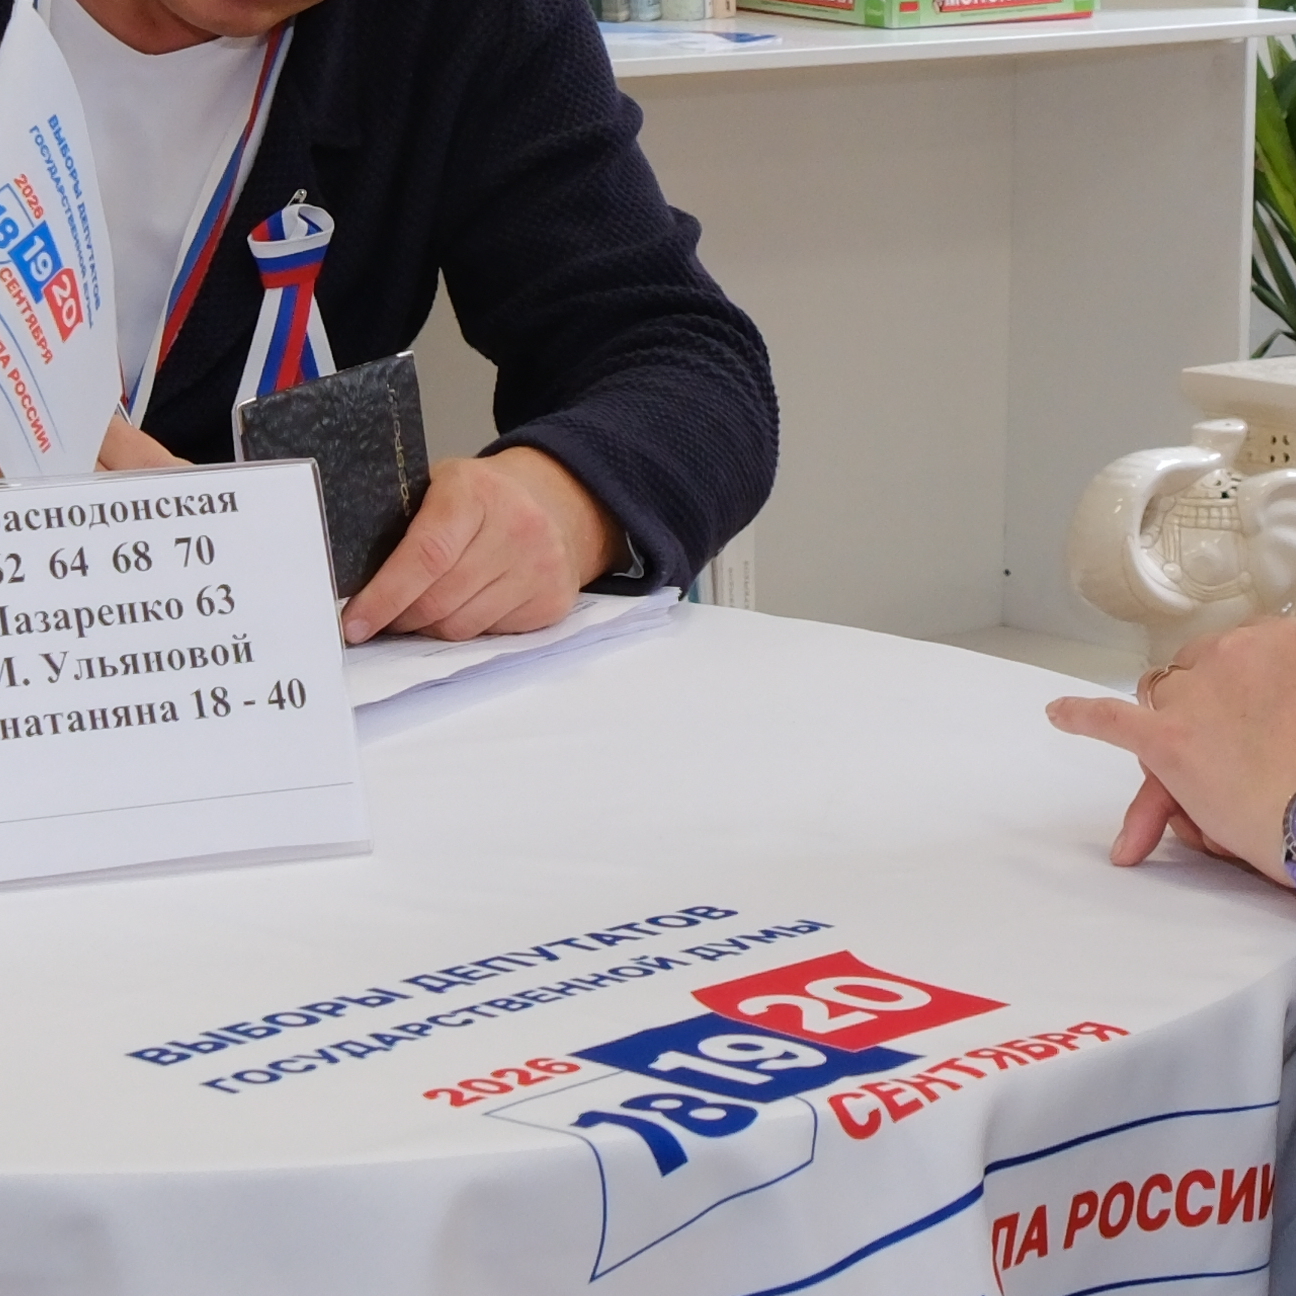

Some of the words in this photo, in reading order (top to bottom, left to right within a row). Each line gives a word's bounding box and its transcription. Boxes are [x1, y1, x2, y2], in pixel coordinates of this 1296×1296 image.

[48, 114, 83, 201] ВЫБОРЫ
[13, 173, 44, 220] 2026
[29, 125, 88, 280] ГОСУДАРСТВЕННОЙ
[21, 235, 53, 283] 19
[52, 267, 77, 328] 20
[7, 367, 52, 453] РОССИИ!
[49, 546, 89, 580] 64
[112, 540, 153, 573] 68
[175, 535, 215, 568] 70
[195, 584, 237, 617] 63
[40, 634, 255, 681] Ульяновой
[191, 686, 232, 720] 18
[268, 676, 307, 711] 40
[126, 987, 413, 1067] ВЫБОРЫ
[400, 904, 739, 994] ДЕПУТАТОВ
[200, 952, 693, 1094] ГОСУДАРСТВЕННОЙ
[683, 918, 835, 963] ДУМЫ
[737, 975, 933, 1035] 20
[422, 1057, 582, 1108] 2026
[648, 1032, 828, 1088] 19
[826, 1020, 1132, 1141] СЕНТЯБРЯ
[570, 1092, 758, 1177] 18
